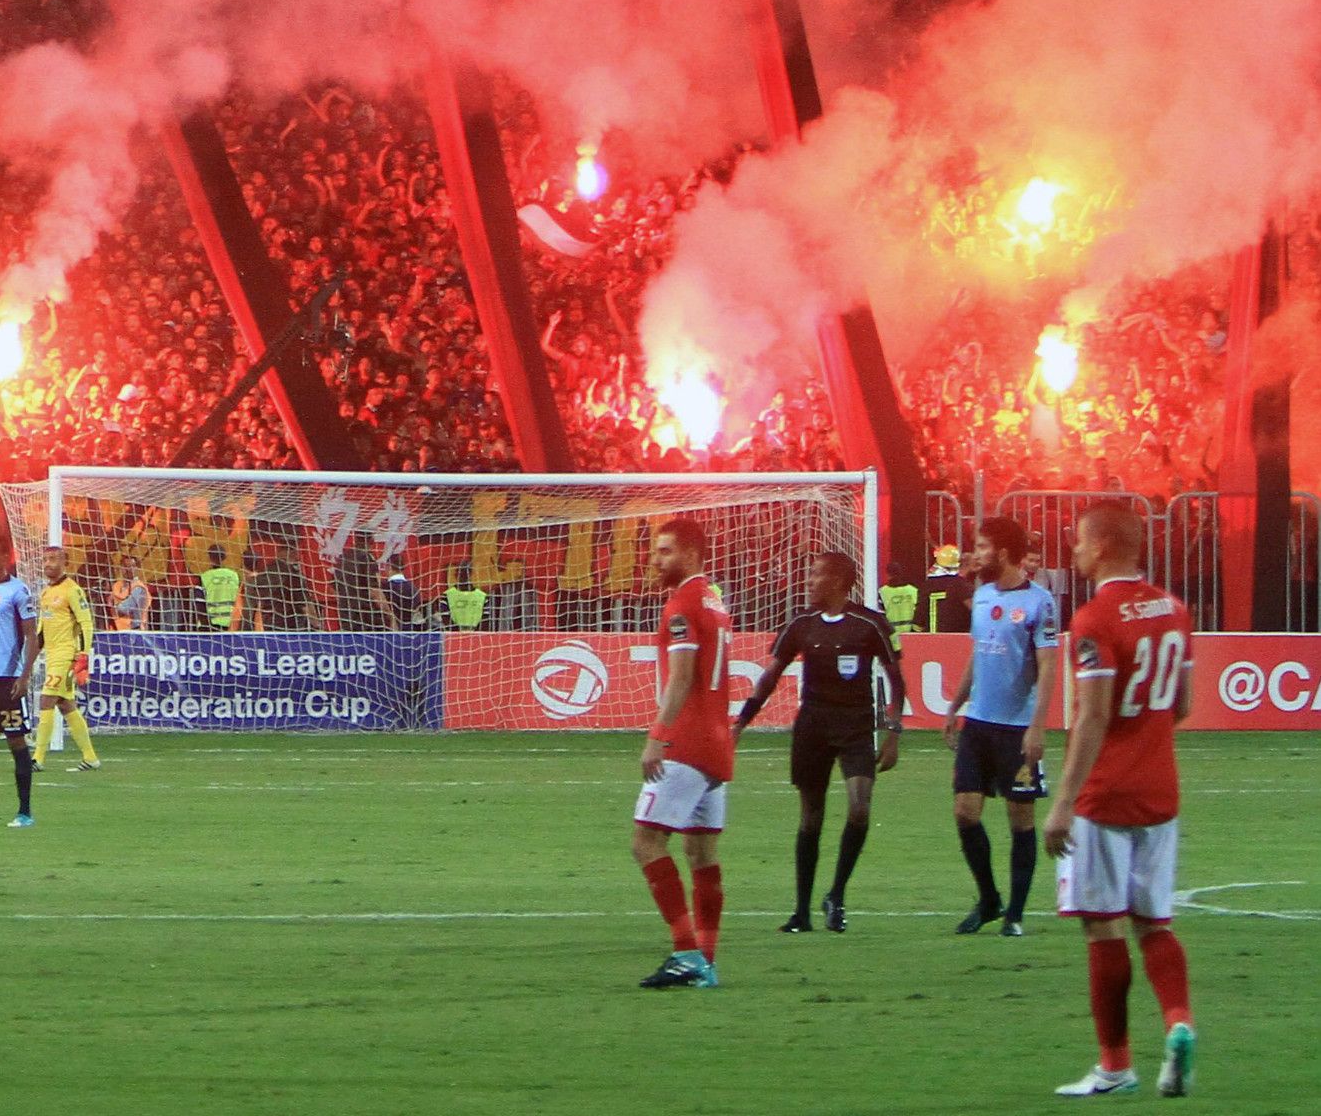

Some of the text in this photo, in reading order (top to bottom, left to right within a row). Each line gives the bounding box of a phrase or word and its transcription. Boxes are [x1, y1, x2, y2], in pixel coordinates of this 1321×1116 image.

[88, 648, 376, 682] hampions League
[1119, 630, 1185, 717] 20
[1219, 660, 1321, 712] @C
[0, 710, 24, 728] 25
[304, 690, 371, 723] Cup
